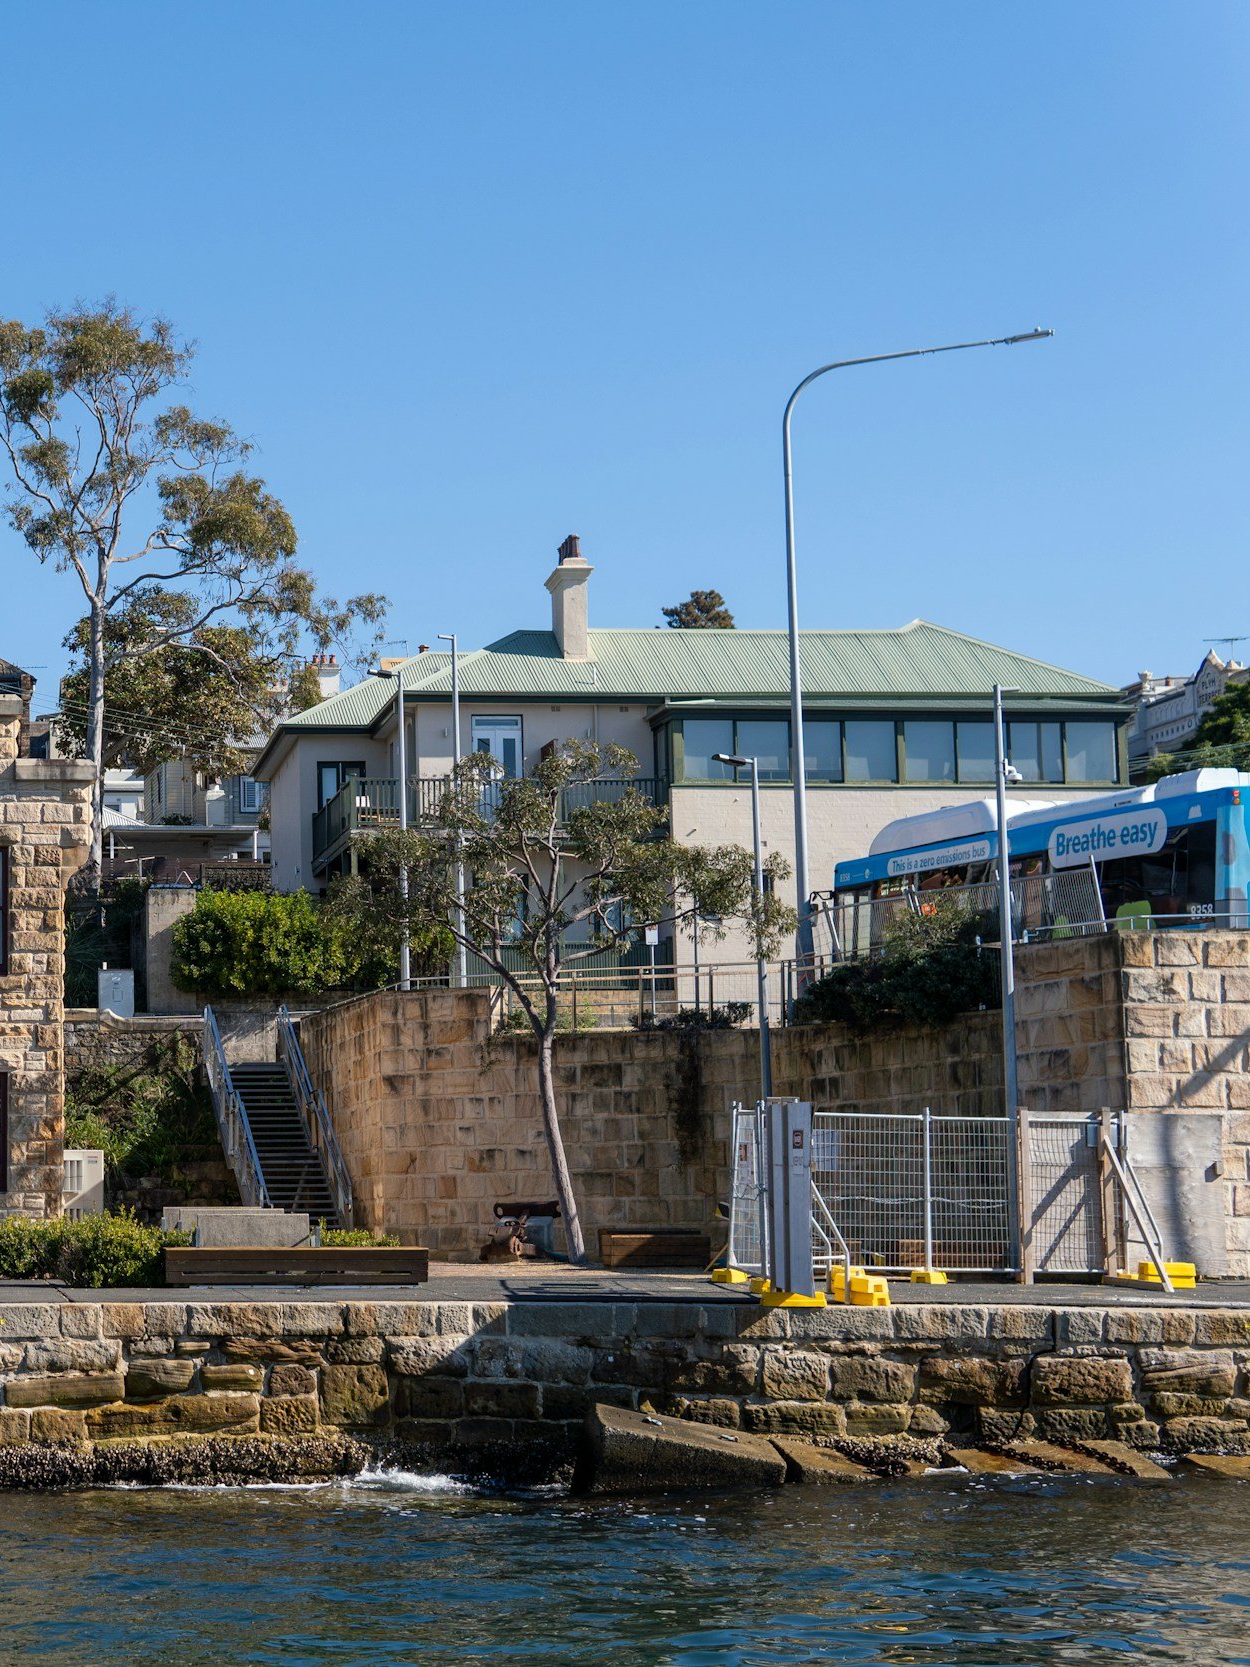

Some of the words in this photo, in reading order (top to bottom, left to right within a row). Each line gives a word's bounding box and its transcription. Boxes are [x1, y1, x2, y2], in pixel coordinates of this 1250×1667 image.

[1056, 823, 1116, 857] Breathe
[1120, 821, 1158, 848] easy
[892, 859, 905, 873] This
[907, 858, 912, 870] is
[920, 858, 935, 868] zero
[936, 849, 970, 865] emissions
[972, 845, 985, 858] bus
[1190, 903, 1213, 920] 8358
